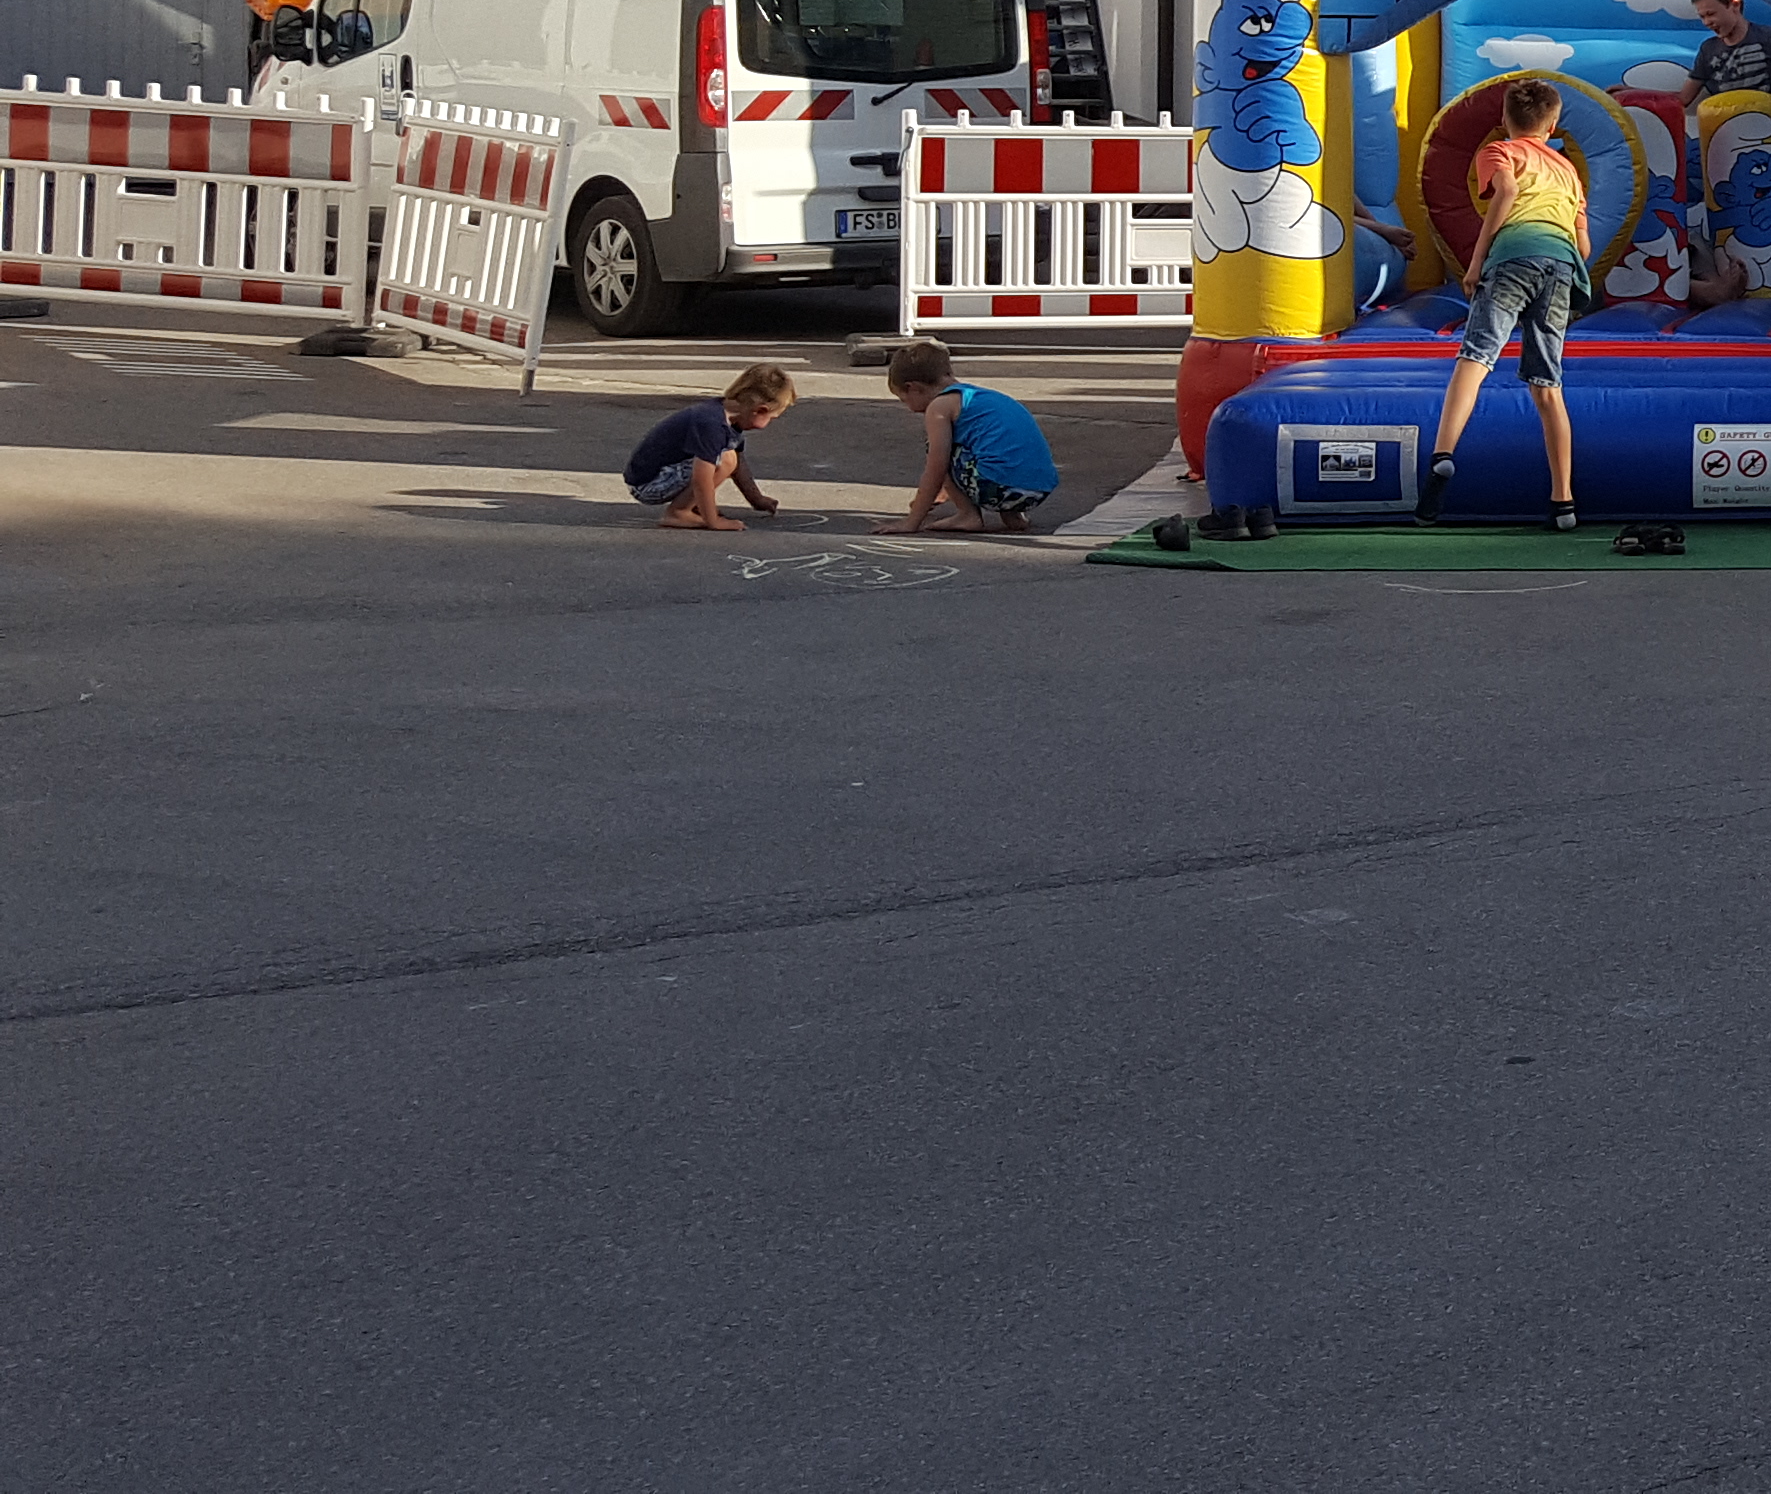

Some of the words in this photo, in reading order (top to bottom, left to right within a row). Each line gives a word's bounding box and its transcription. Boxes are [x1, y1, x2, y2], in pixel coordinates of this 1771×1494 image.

[853, 212, 875, 231] FS
[886, 212, 900, 230] B
[1720, 431, 1758, 439] SAFETY
